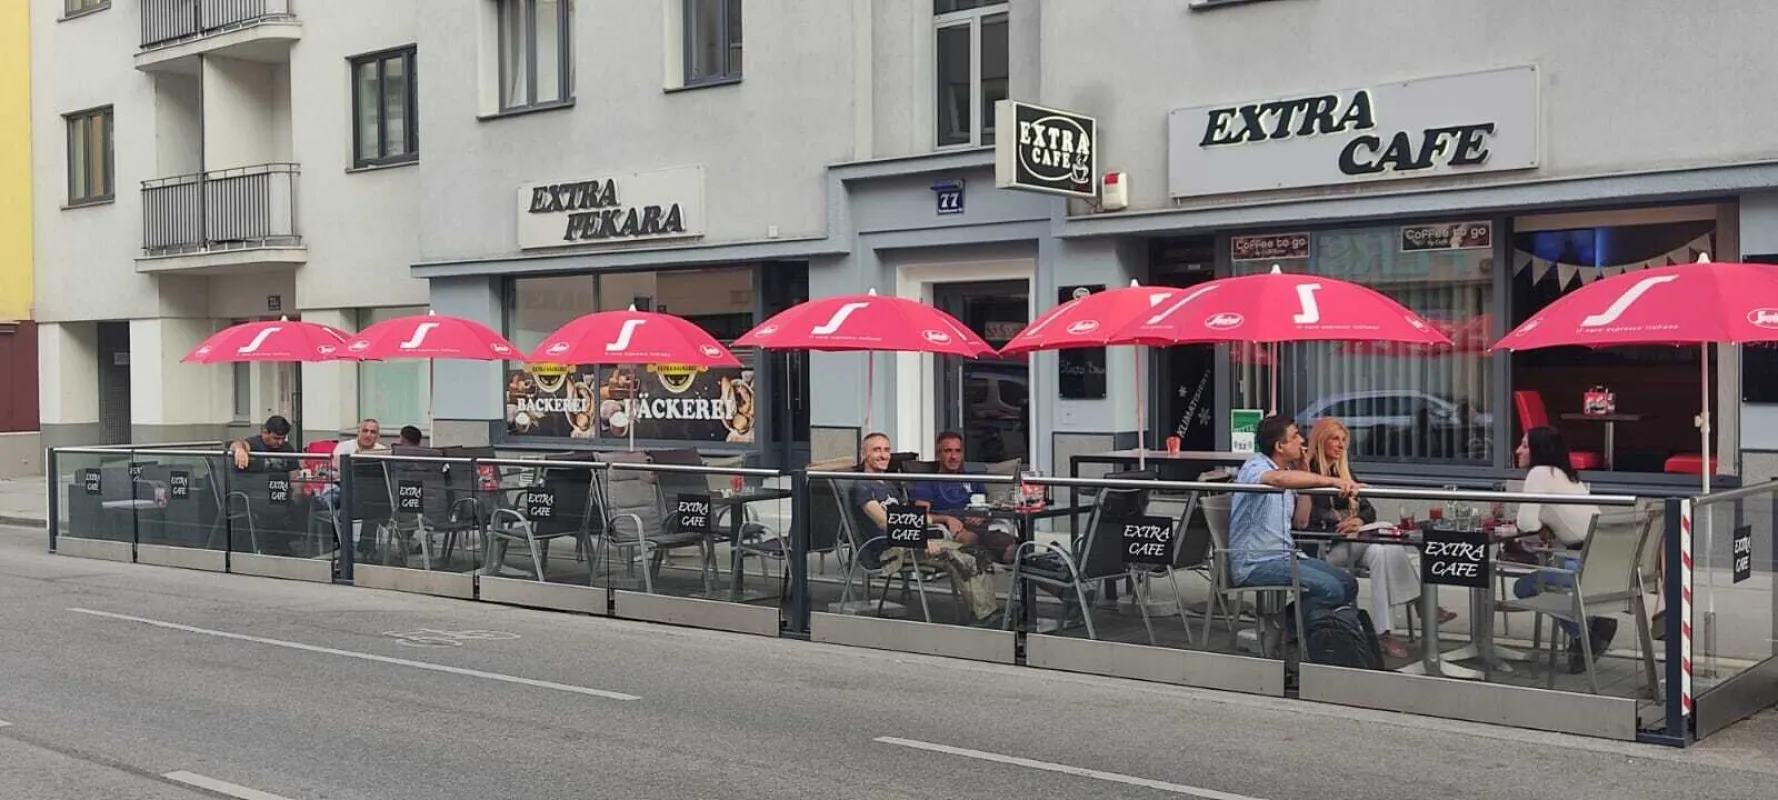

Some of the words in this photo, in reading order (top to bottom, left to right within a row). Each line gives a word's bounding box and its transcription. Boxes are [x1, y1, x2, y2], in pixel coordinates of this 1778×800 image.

[1198, 90, 1376, 148] EXTRA
[1020, 121, 1090, 155] EXTRA
[1338, 122, 1495, 175] CAFE
[1031, 147, 1071, 169] CAFE
[528, 178, 621, 214] EXTRA
[940, 193, 960, 208] 77
[563, 203, 687, 241] PEKARA
[1470, 227, 1487, 239] go
[1292, 238, 1306, 249] go
[517, 394, 587, 412] BÄCKEREI
[400, 486, 422, 498] EXTRA
[528, 493, 554, 506] EXTRA
[401, 498, 420, 508] CAFE
[678, 501, 709, 516] EXTRA
[530, 506, 551, 517] CAFE
[681, 515, 706, 528] CAFE
[888, 512, 925, 529] EXTRA
[892, 528, 921, 542] CAFE
[1123, 524, 1170, 542] EXTRA
[1128, 542, 1166, 556] CAFE
[1424, 541, 1485, 562] EXTRA
[1431, 561, 1479, 578] CAFE
